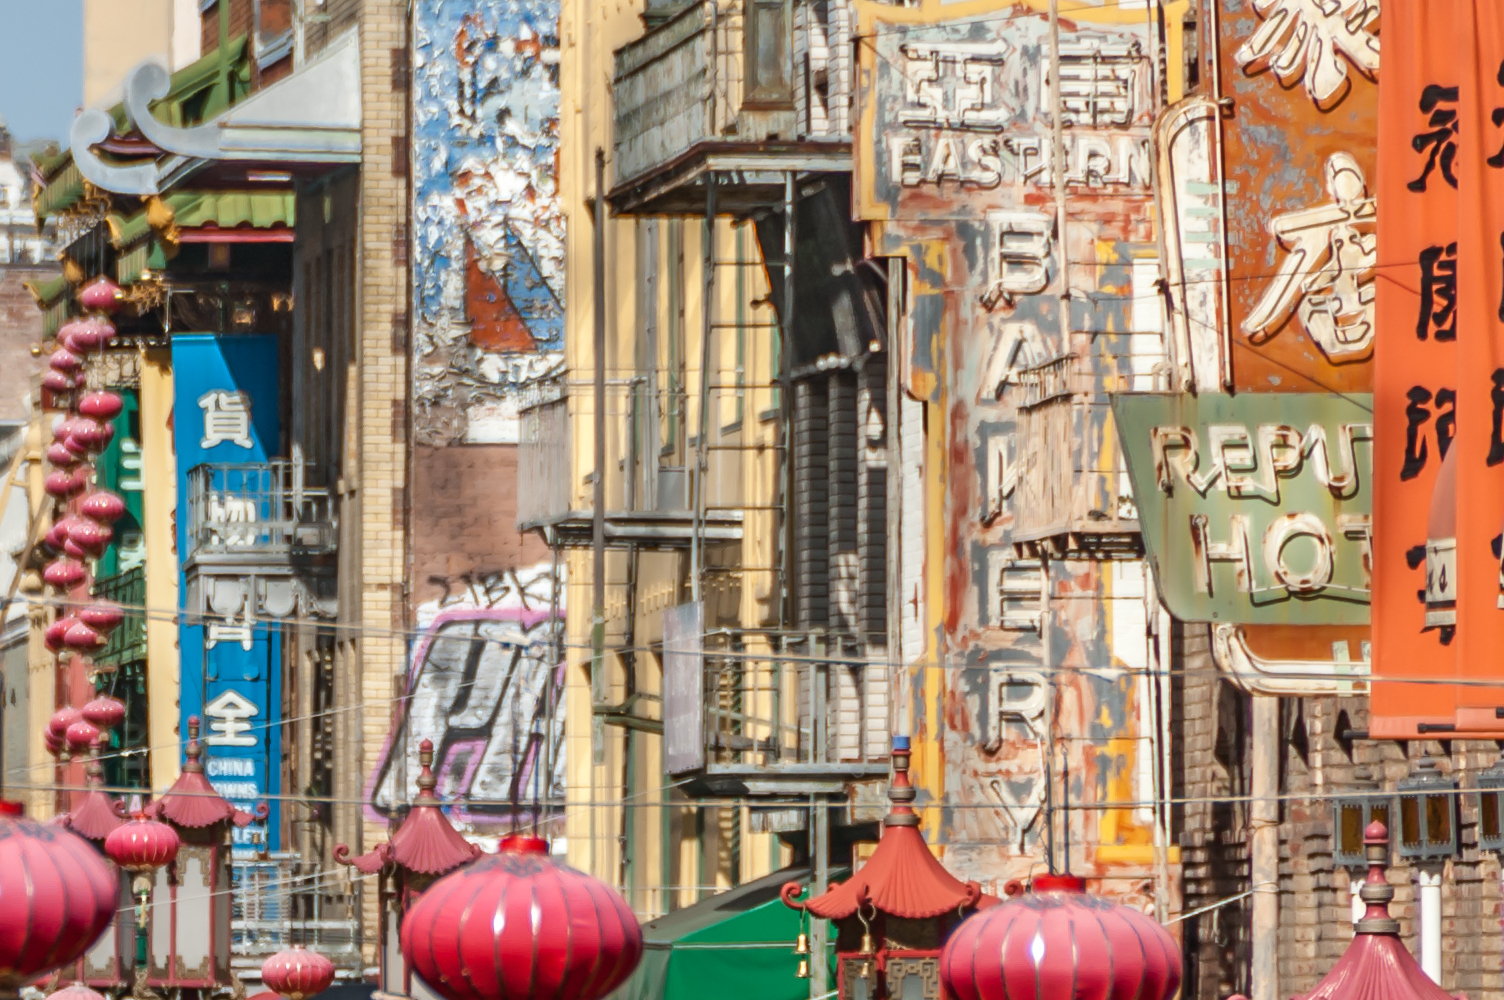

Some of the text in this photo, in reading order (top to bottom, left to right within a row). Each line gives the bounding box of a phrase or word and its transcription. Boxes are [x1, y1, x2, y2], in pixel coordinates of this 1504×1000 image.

[1151, 424, 1372, 499] REPU
[208, 757, 254, 777] CHINA
[212, 782, 258, 800] OWNS
